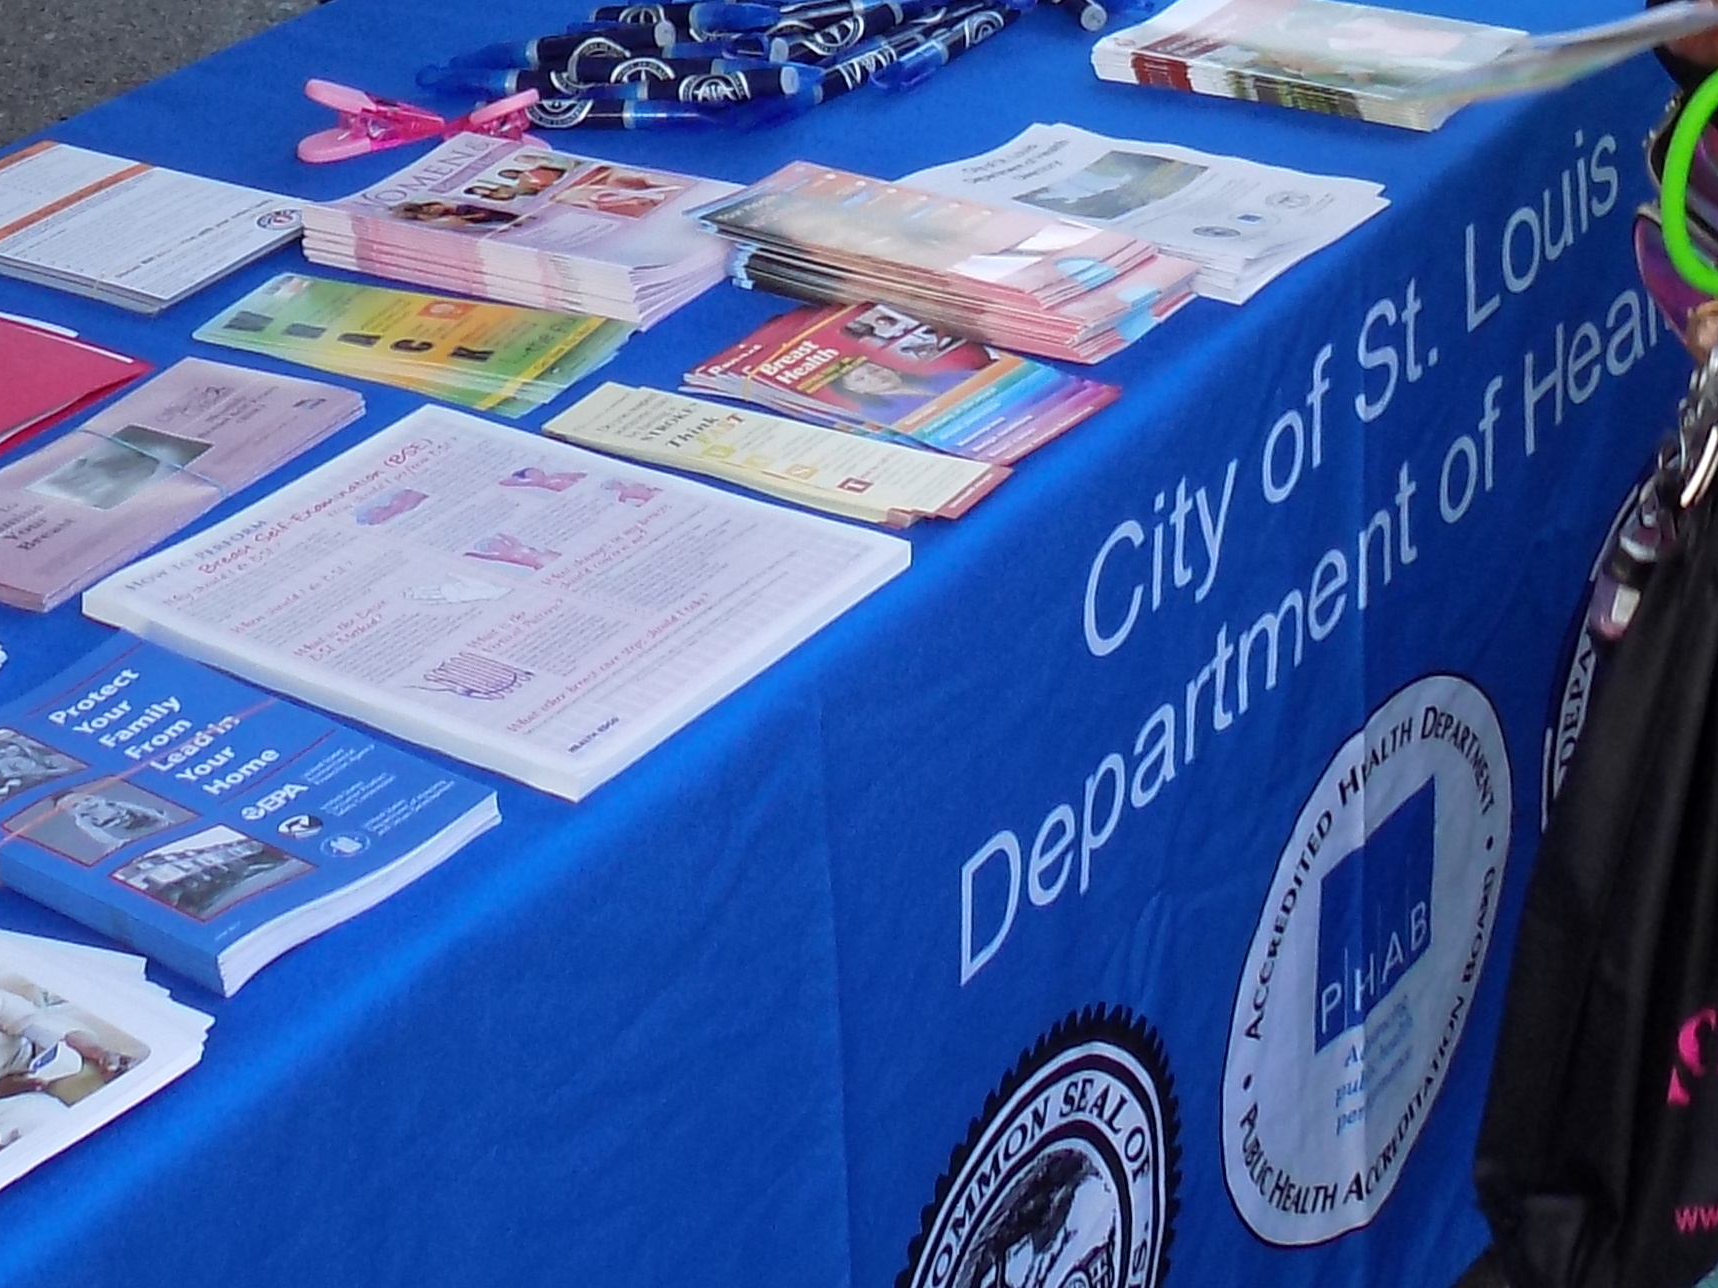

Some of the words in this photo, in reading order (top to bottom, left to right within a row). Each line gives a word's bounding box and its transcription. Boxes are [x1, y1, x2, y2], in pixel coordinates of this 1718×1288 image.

[757, 338, 821, 377] Breast
[775, 347, 840, 385] Health
[1085, 459, 1236, 658] City
[1262, 356, 1336, 505] of
[1354, 278, 1440, 424] St.
[1464, 132, 1622, 331] Louis
[666, 415, 720, 450] Think
[197, 543, 258, 575] Breast
[253, 467, 382, 545] Self-Examination
[384, 436, 434, 470] (BSE)
[196, 519, 268, 563] PERFORM
[48, 668, 140, 725] Protect
[73, 698, 133, 737] Your
[959, 471, 1419, 987] Department
[1438, 396, 1501, 525] of
[98, 694, 183, 751] Family
[123, 717, 193, 762] From
[149, 729, 208, 773] Lead
[208, 713, 241, 737] in
[175, 745, 237, 784] Your
[202, 746, 281, 798] Home
[259, 781, 310, 815] EPA
[1245, 812, 1334, 1042] ACCREDITED
[1338, 715, 1413, 808] HEALTH
[1419, 704, 1496, 816] DEPARTMENT
[1238, 1100, 1272, 1199] PUBLIC
[1270, 1171, 1338, 1215] HEALTH
[1343, 995, 1464, 1206] ACCREDITATION
[931, 1095, 1050, 1288] OMMON
[1059, 1078, 1128, 1135] SEAL
[1124, 1125, 1151, 1183] OF
